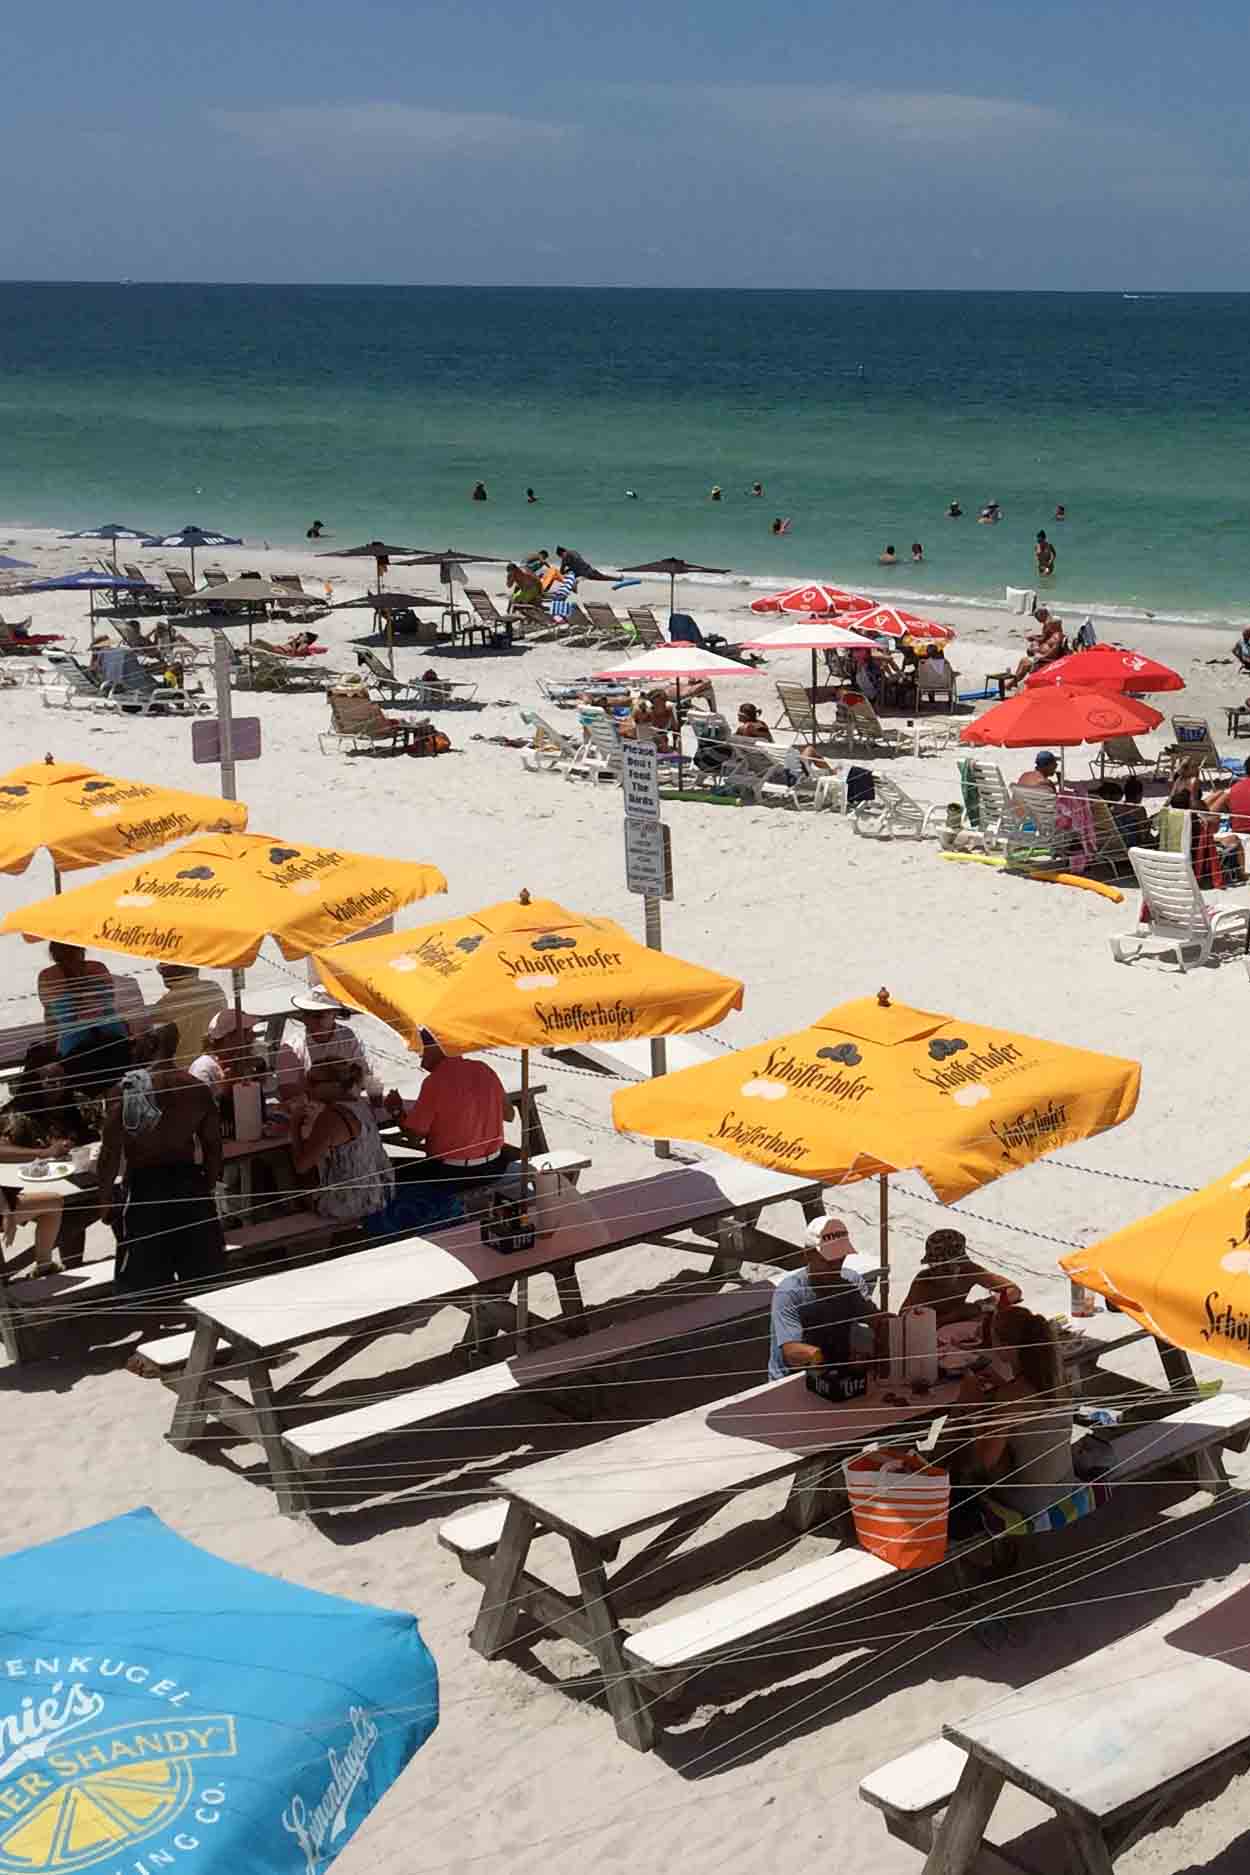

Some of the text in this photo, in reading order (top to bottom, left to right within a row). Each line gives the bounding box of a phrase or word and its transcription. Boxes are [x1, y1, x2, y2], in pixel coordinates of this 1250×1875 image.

[624, 744, 654, 756] Please
[629, 769, 650, 780] Feed
[632, 782, 648, 792] The
[628, 793, 654, 806] Birds
[124, 871, 229, 900] Schöfferhofer
[93, 916, 183, 950] Schöfferhofer
[498, 948, 623, 976] Schöfferhofer
[534, 1000, 636, 1035] Schöfferhofer
[752, 1046, 873, 1101] Schöfferhofer
[912, 1042, 1023, 1096] Schöfferhofer
[708, 1111, 811, 1160] Schöfferhofer
[6, 1657, 191, 1707] ENKUGEL
[49, 1727, 215, 1776] SHANDY
[195, 1782, 225, 1824] CO.
